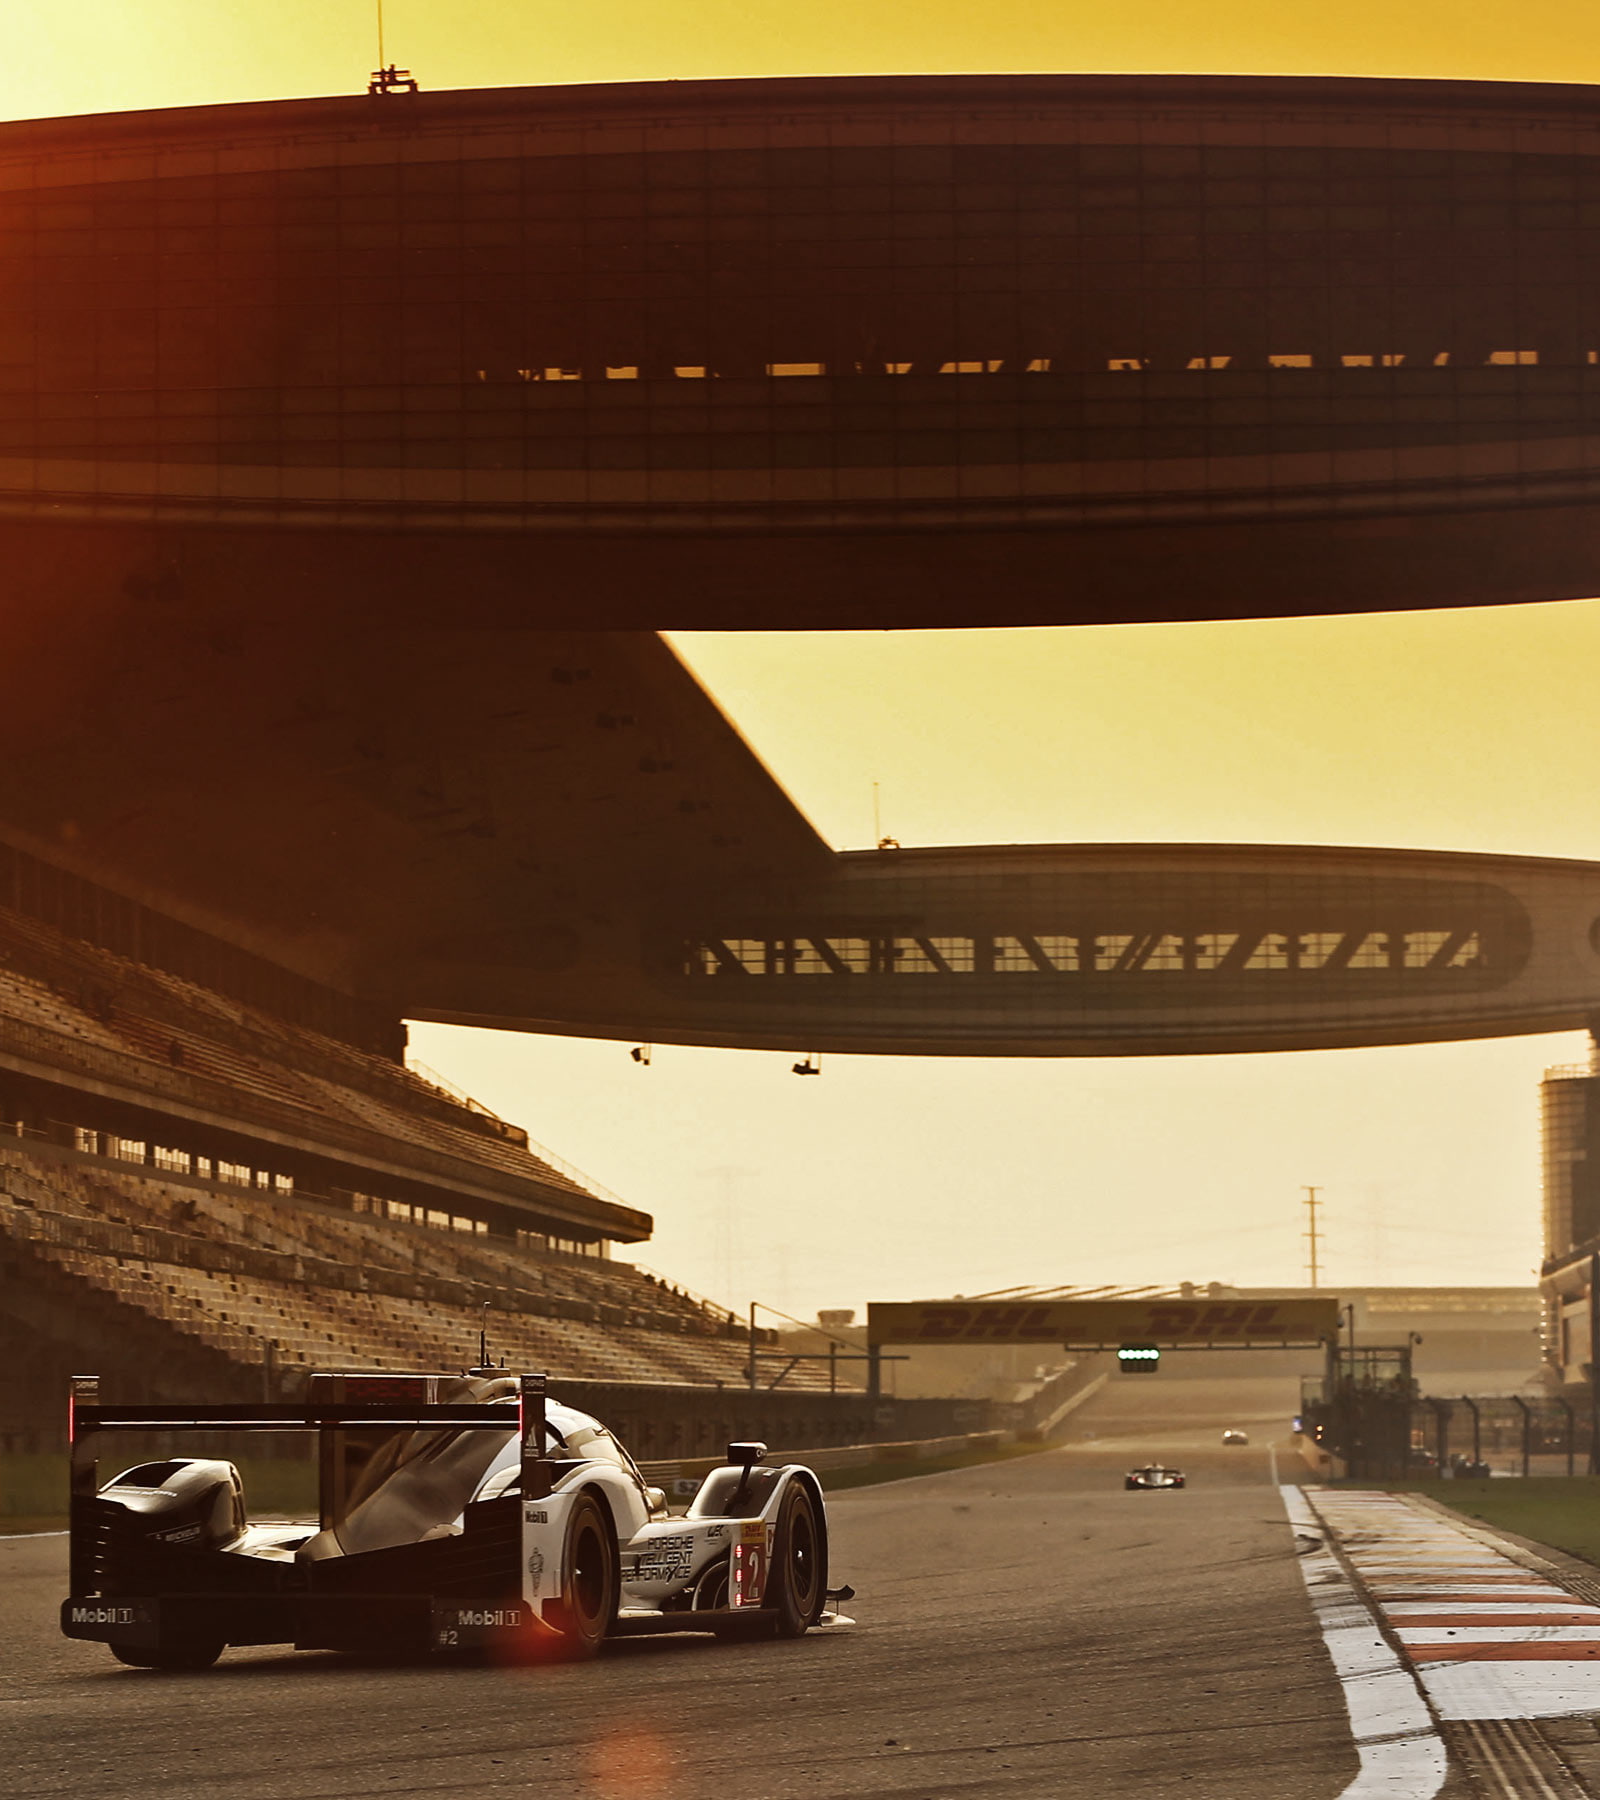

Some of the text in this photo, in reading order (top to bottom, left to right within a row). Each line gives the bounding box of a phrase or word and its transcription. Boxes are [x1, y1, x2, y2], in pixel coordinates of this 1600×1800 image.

[918, 1308, 1058, 1337] DHL
[1145, 1307, 1288, 1336] DHL
[648, 1535, 694, 1550] PORSCHE
[636, 1551, 693, 1566] TELLIGENT
[748, 1551, 760, 1598] 2
[72, 1607, 116, 1623] Mobil
[458, 1610, 504, 1626] Mobil
[439, 1630, 458, 1645] #2
